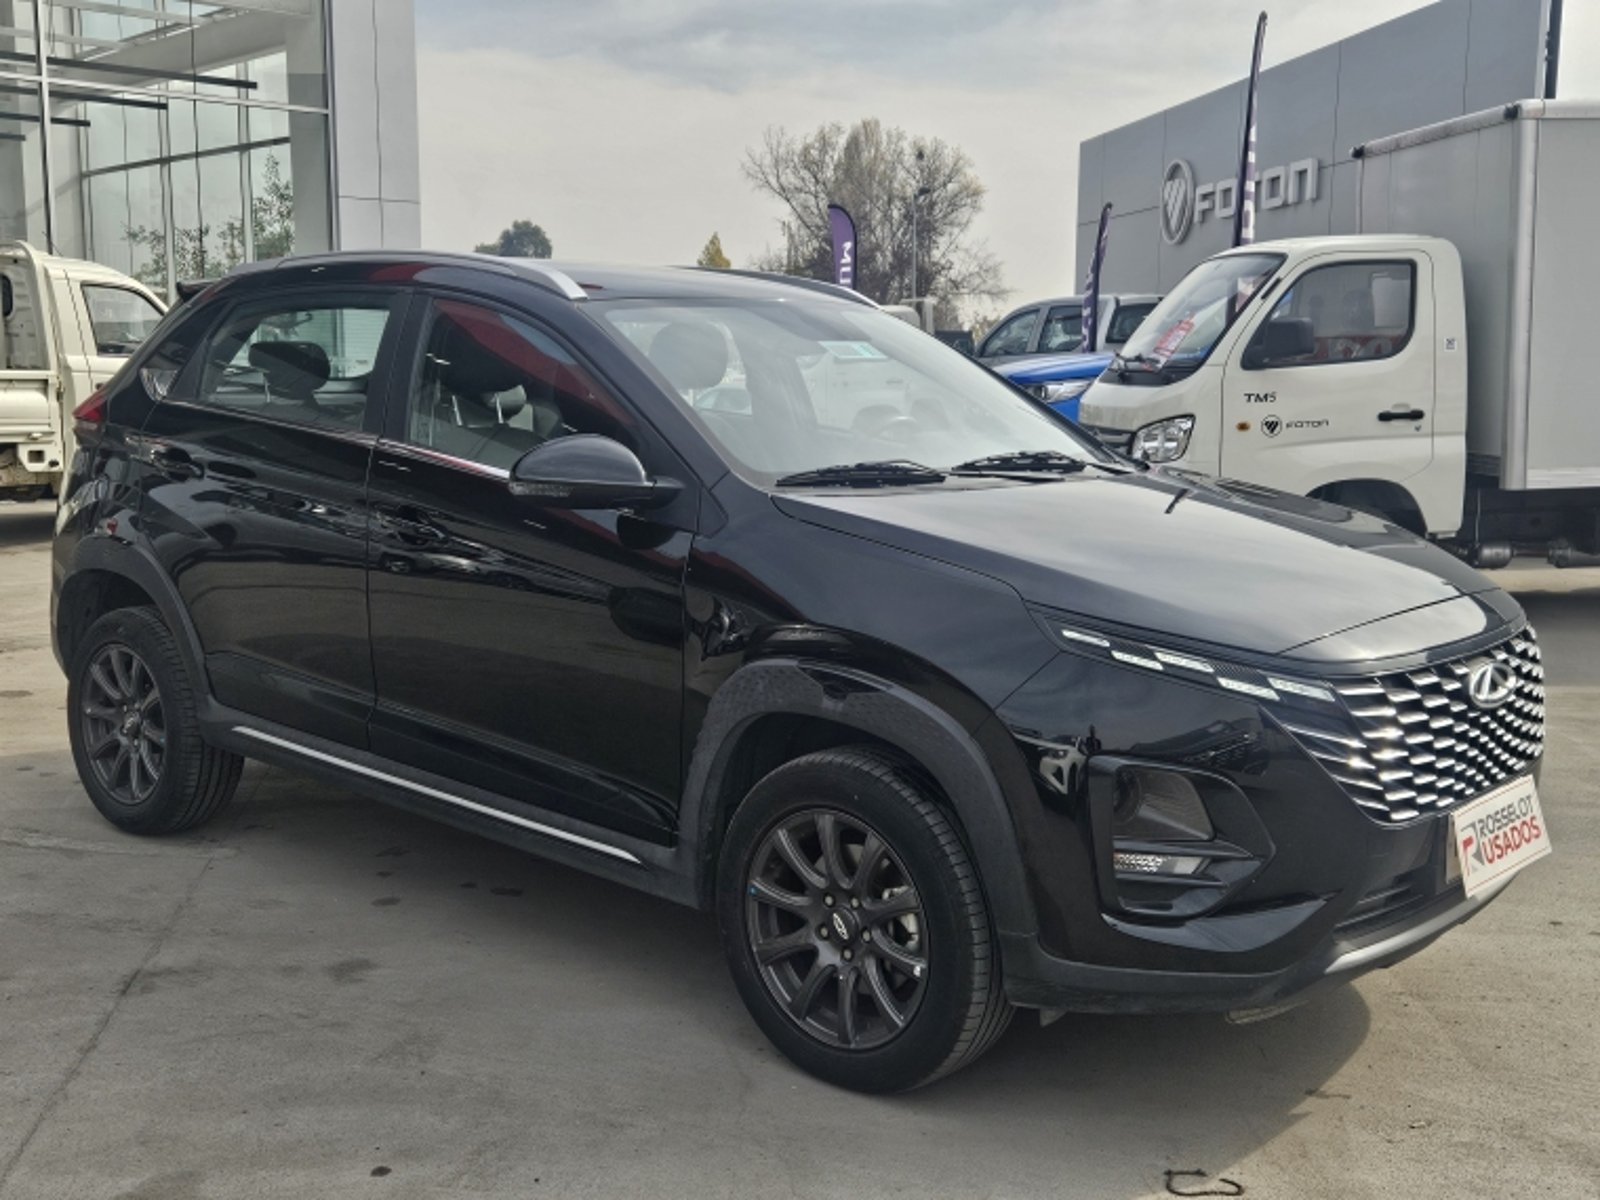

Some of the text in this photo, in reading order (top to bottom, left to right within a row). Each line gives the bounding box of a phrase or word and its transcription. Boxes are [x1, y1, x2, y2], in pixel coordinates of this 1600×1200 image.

[1243, 391, 1278, 403] TM5
[1477, 795, 1534, 837] ROSSELOT
[1481, 815, 1542, 865] USADOS
